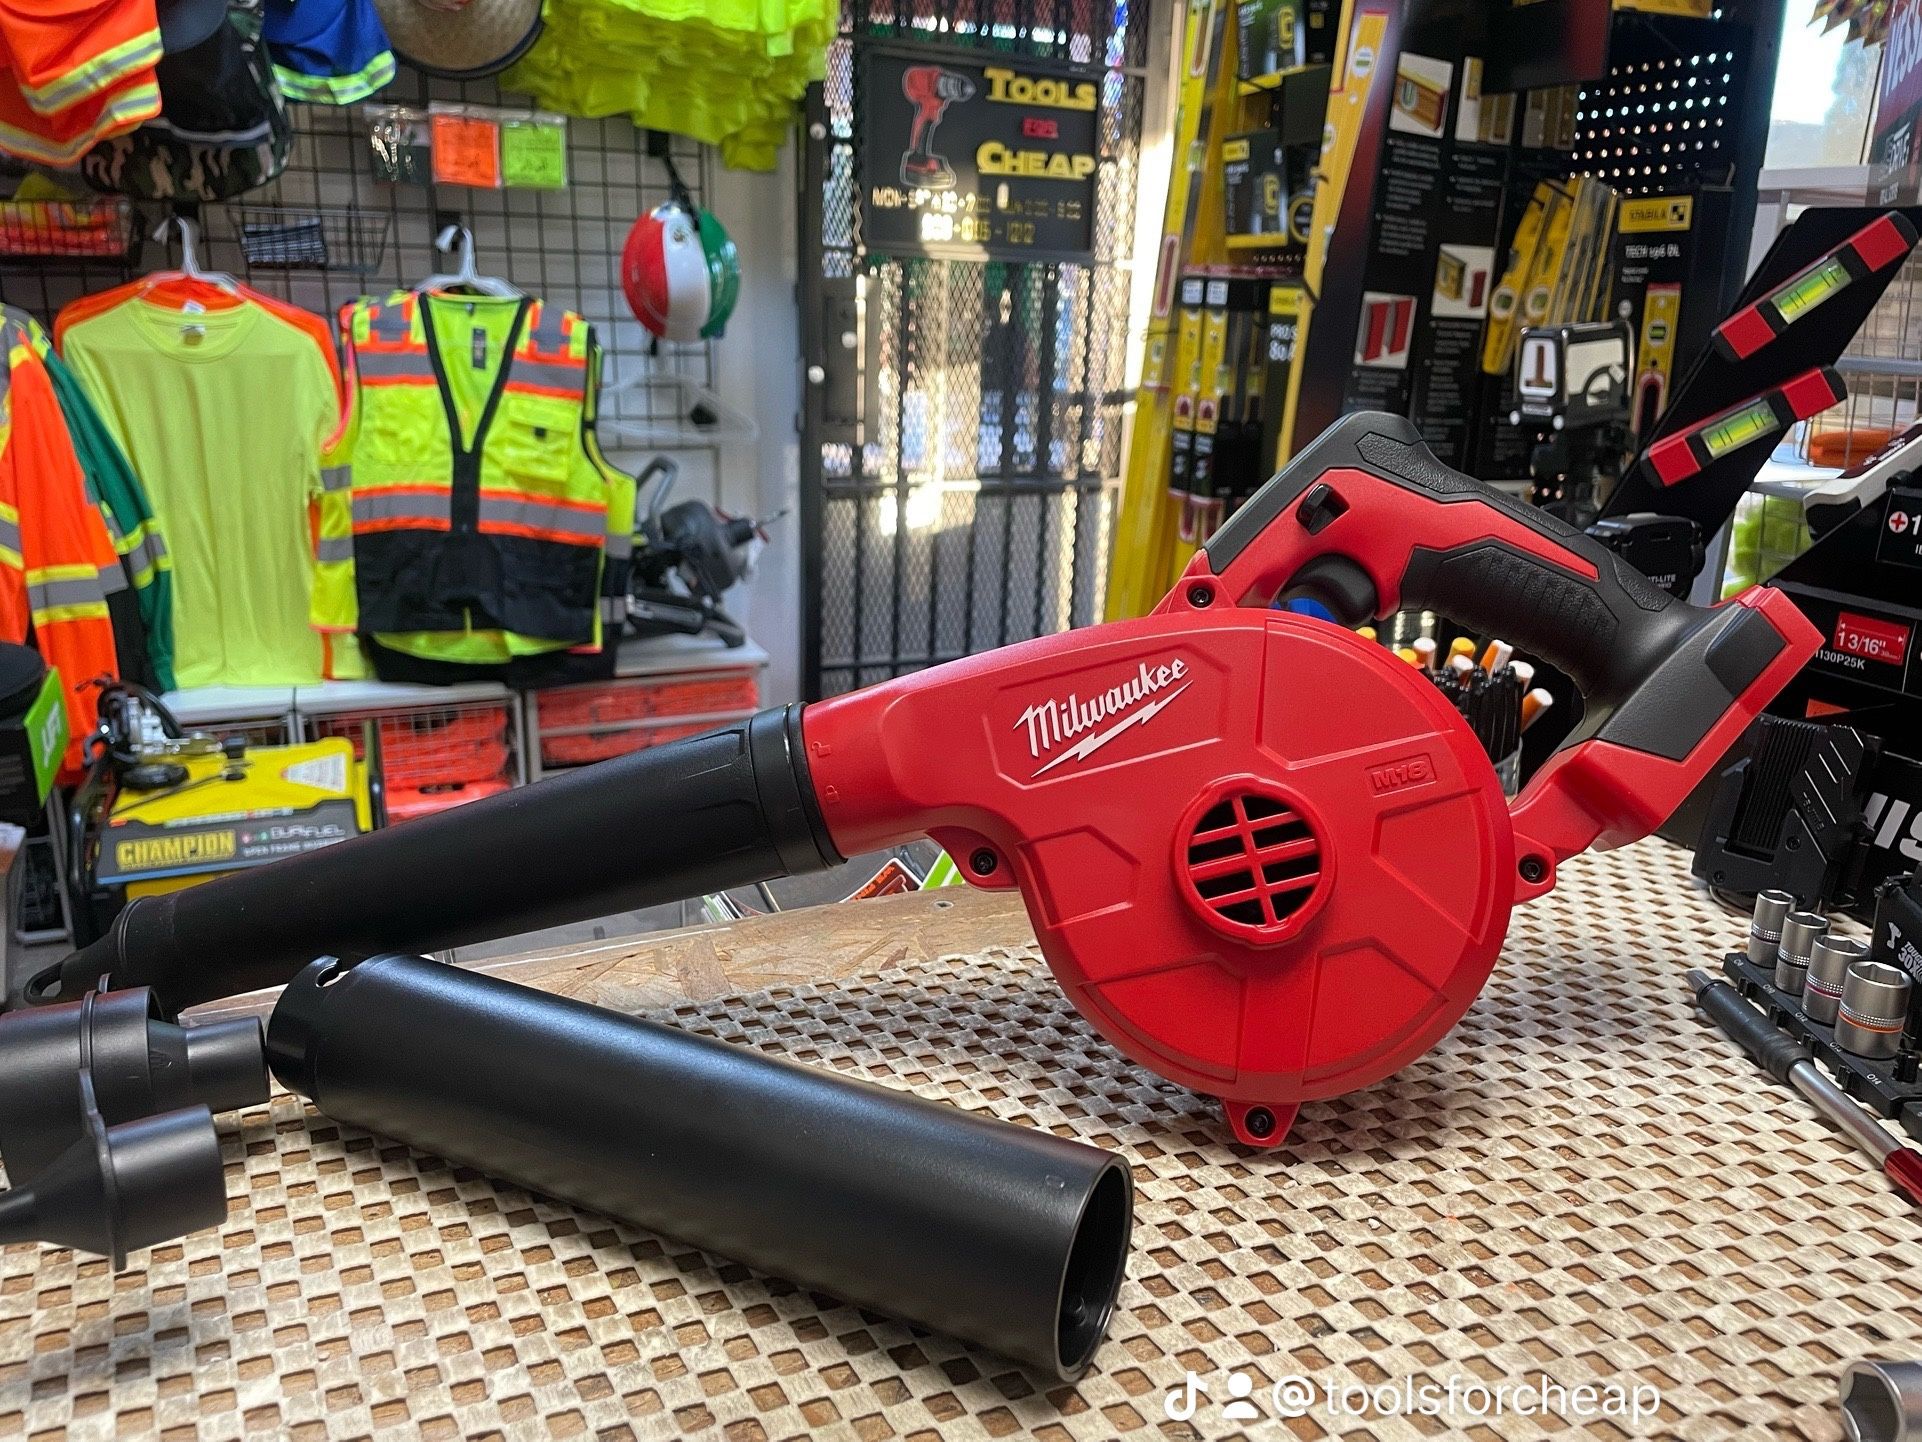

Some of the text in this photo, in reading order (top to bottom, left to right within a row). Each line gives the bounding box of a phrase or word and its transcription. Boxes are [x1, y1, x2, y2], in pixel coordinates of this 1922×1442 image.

[984, 67, 1097, 111] TOOLS
[976, 140, 1096, 181] CHEAP
[1012, 657, 1190, 758] Milwaukee
[1371, 760, 1428, 791] M18
[118, 831, 235, 867] CHAMPION
